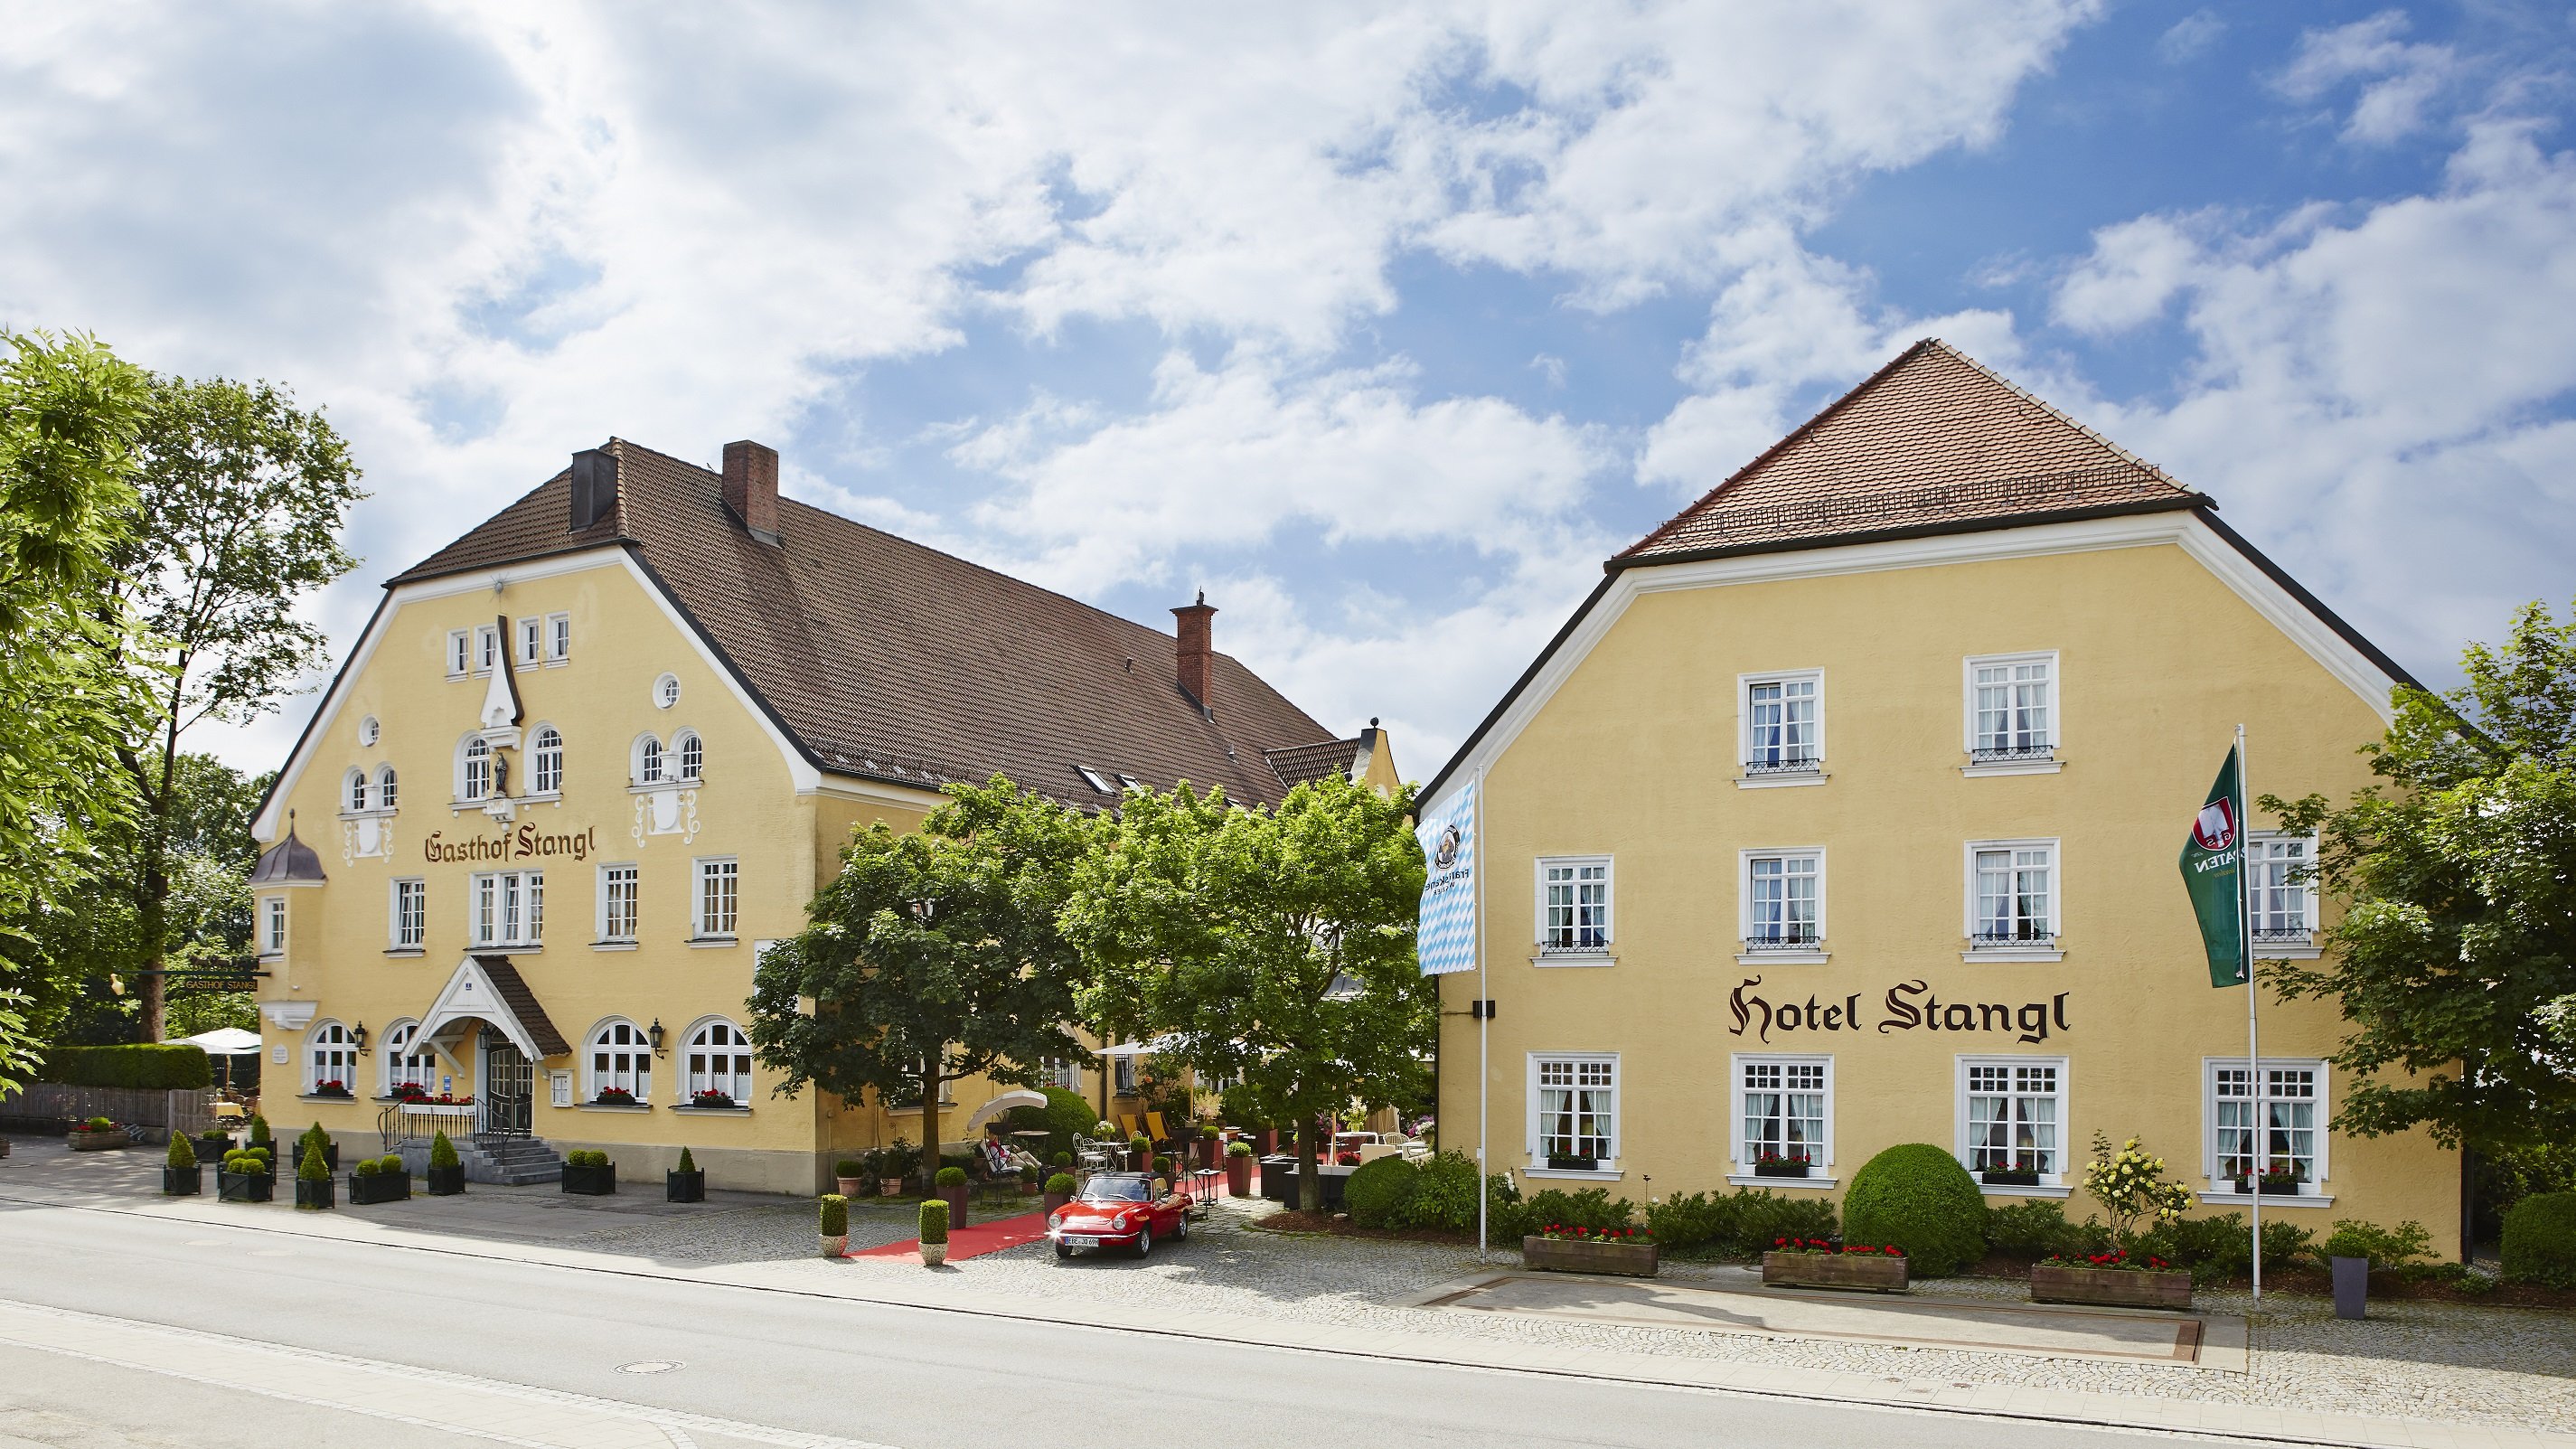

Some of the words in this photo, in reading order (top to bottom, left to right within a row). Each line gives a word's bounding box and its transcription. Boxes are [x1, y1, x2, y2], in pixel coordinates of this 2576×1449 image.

[425, 831, 512, 862] Gasthof
[514, 822, 596, 861] Stangl
[186, 980, 225, 990] GASTHOF
[227, 980, 258, 990] STANGL
[1728, 974, 1863, 1045] Hotel
[1877, 979, 2072, 1045] Stangl
